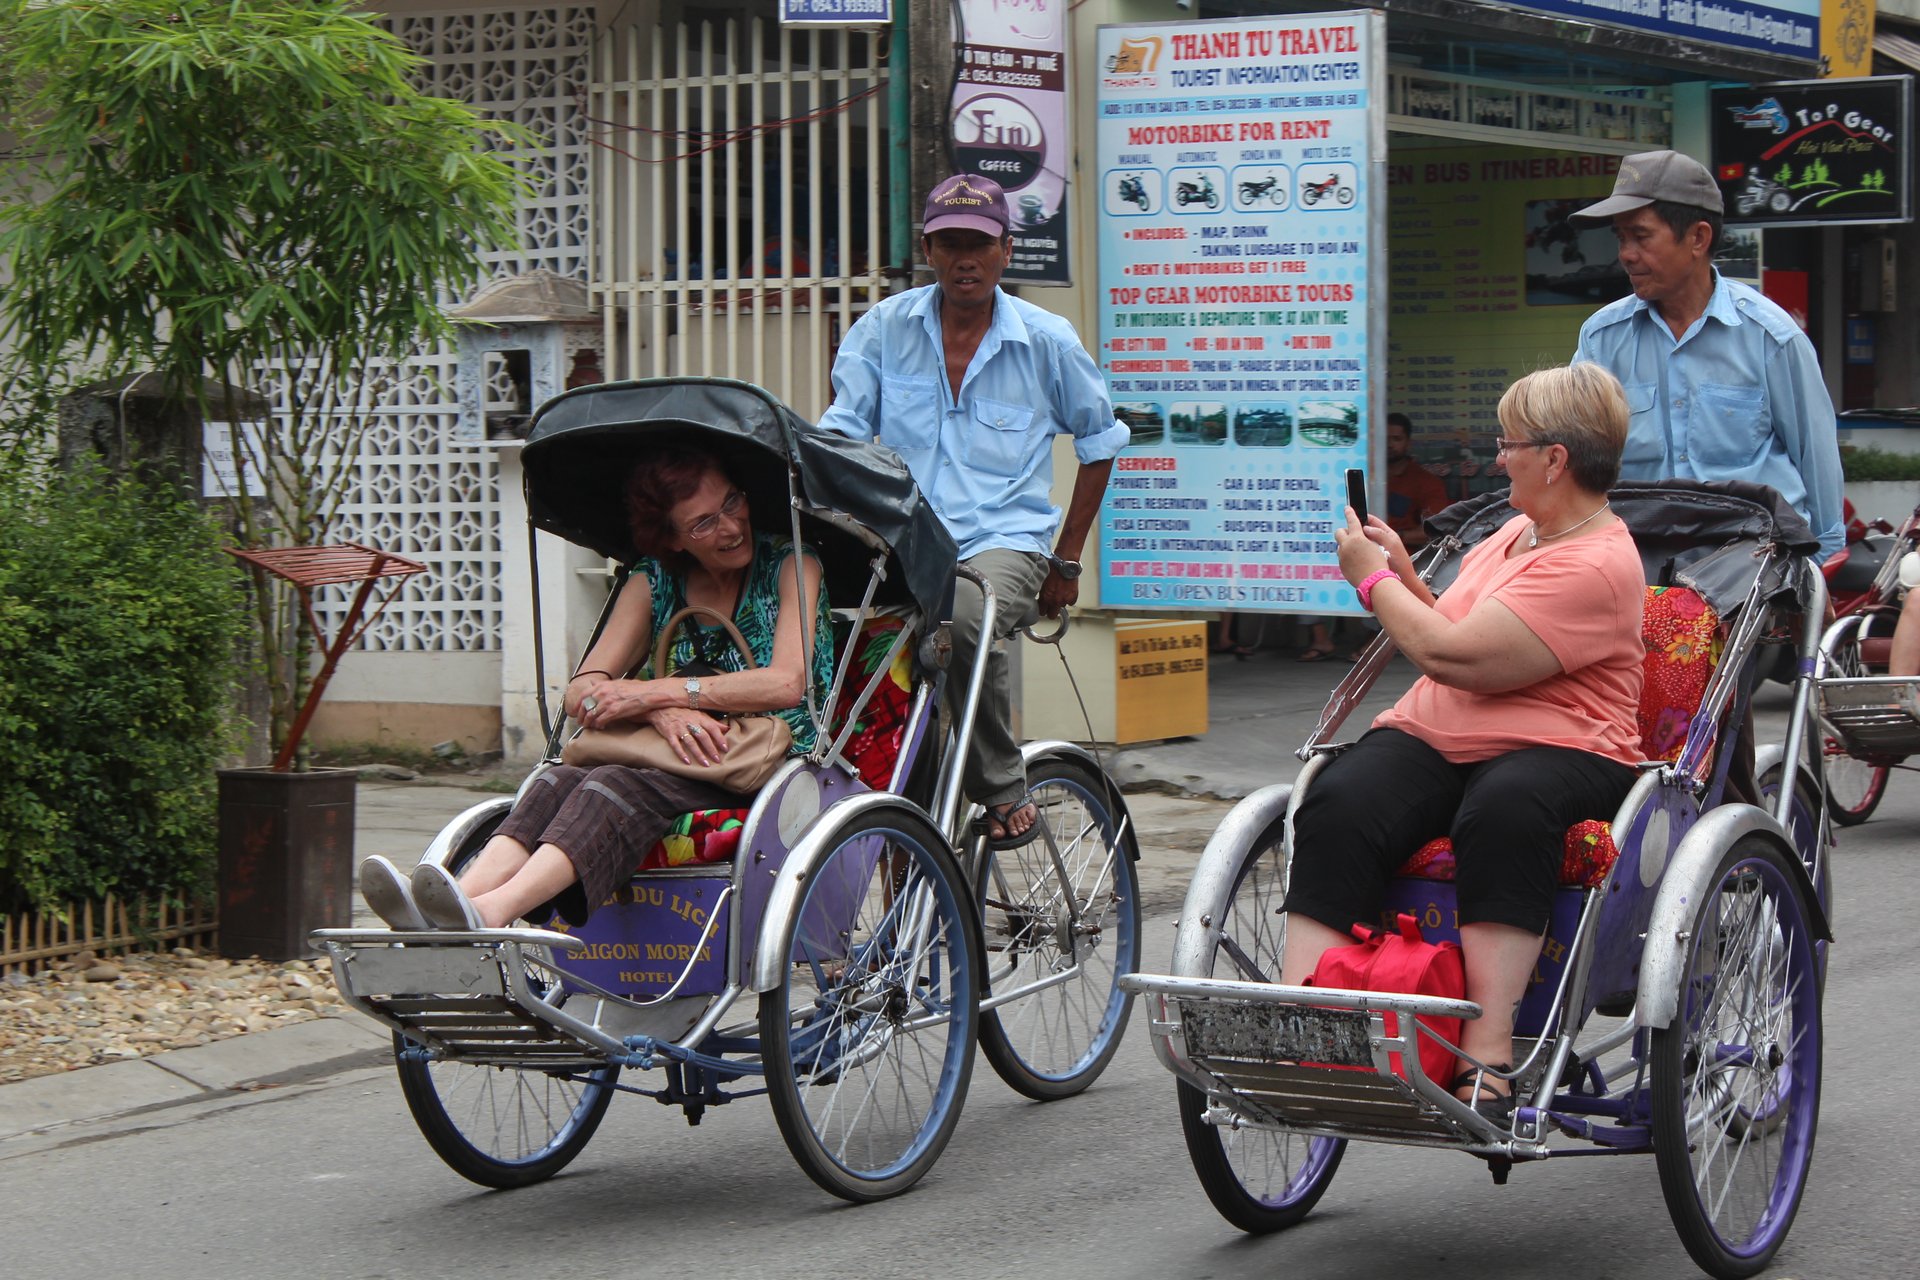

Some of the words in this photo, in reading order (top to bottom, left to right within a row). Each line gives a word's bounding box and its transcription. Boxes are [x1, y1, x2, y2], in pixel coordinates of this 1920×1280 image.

[1171, 32, 1240, 60] THANH
[1246, 30, 1273, 57] TU
[1279, 26, 1359, 55] TRAVEL
[1171, 68, 1221, 87] TOURIST
[1226, 65, 1309, 86] INFORMATION
[1312, 62, 1359, 82] CENTER
[1128, 123, 1233, 145] MOTORBIKE
[1239, 122, 1275, 142] FOR
[1281, 120, 1331, 140] RENT
[1118, 154, 1152, 164] MANUAL
[1176, 152, 1218, 162] AUTOMATIC
[1240, 150, 1266, 160] HONDA
[1302, 148, 1323, 158] MOTO
[979, 159, 1022, 173] COFFEE
[1388, 164, 1413, 185] EN
[1424, 162, 1470, 184] BUS
[1482, 156, 1617, 181] ITINERARIE
[944, 197, 982, 206] TOURIST
[1232, 226, 1268, 238] DRINK
[1202, 245, 1240, 256] TAKING
[1245, 243, 1297, 256] LUGGAGE
[1300, 243, 1314, 254] TO
[1318, 242, 1338, 254] HOI
[1341, 242, 1358, 254] AN
[1133, 263, 1159, 276] RENT
[1174, 262, 1244, 274] MOTORBIKES
[1250, 262, 1269, 274] GET
[1281, 260, 1306, 272] FREE
[1110, 288, 1141, 305] TOP
[1146, 287, 1190, 304] GEAR
[1194, 285, 1292, 304] MOTORBIKE
[1297, 284, 1354, 302] TOURS
[1115, 314, 1127, 327] BY
[1130, 312, 1186, 326] MOTORBIKE
[1200, 312, 1256, 326] DEPARTURE
[1258, 311, 1282, 325] TIME
[1286, 311, 1297, 325] AT
[1300, 310, 1320, 325] ANY
[1324, 310, 1348, 324] TIME
[1128, 338, 1144, 351] CITY
[1146, 338, 1167, 351] TOUR
[1244, 336, 1264, 350] TOUR
[1311, 336, 1332, 350] TOUR
[1238, 360, 1272, 372] PARADISE
[1274, 360, 1291, 372] CAVE
[1328, 360, 1361, 372] NATIONAL
[1135, 380, 1158, 392] THUAN
[1202, 380, 1227, 392] THANH
[1246, 380, 1280, 392] MINERAL
[1282, 379, 1297, 392] HOT
[1114, 478, 1150, 490] PRIVATE
[1153, 478, 1178, 490] TOUR
[1224, 479, 1243, 490] CAR
[1257, 479, 1281, 490] BOAT
[1284, 479, 1320, 491] RENTAL
[1113, 498, 1142, 510] HOTEL
[1144, 498, 1208, 510] RESERVATION
[1224, 500, 1263, 512] HALONG
[1276, 500, 1301, 512] SAPA
[1304, 500, 1331, 512] TOUR
[1114, 519, 1135, 531] VISA
[1138, 519, 1190, 531] EXTENSION
[1224, 520, 1274, 533] BUS/OPEN
[1276, 521, 1296, 533] BUS
[1299, 521, 1333, 533] TICKET
[1113, 538, 1147, 550] DOMES
[1160, 539, 1234, 552] INTERNATIONAL
[1236, 540, 1269, 552] FLIGHT
[1283, 541, 1311, 553] TRAIN
[1134, 583, 1161, 599] BUS
[1174, 584, 1214, 600] OPEN
[1217, 585, 1246, 602] BUS
[1252, 587, 1307, 602] TICKET
[632, 885, 664, 906] DU
[567, 943, 640, 961] SAIGON
[619, 971, 676, 984] HOTEL
